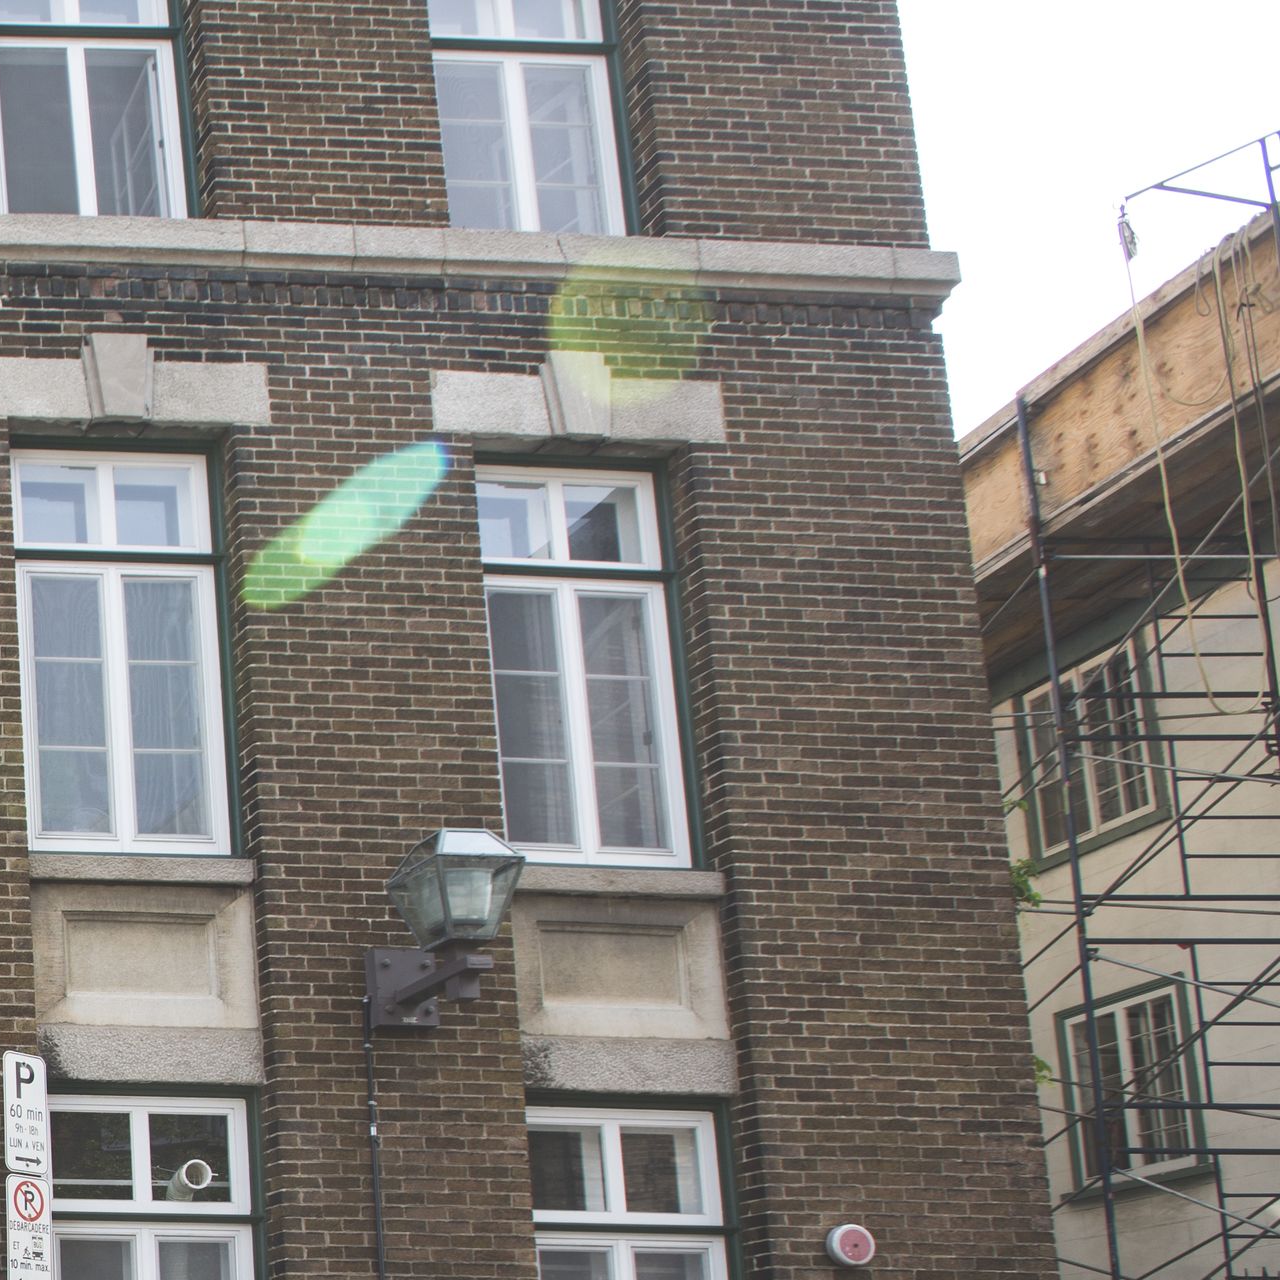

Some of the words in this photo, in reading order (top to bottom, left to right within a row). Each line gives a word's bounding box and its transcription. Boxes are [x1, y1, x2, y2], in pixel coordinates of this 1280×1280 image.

[15, 1061, 35, 1099] P
[9, 1104, 22, 1118] 60
[26, 1107, 43, 1122] min
[9, 1137, 23, 1149] LUN
[31, 1141, 45, 1152] VEN
[13, 1241, 20, 1250] ET
[10, 1259, 19, 1269] 10
[20, 1260, 34, 1271] min.
[35, 1263, 51, 1273] max.
